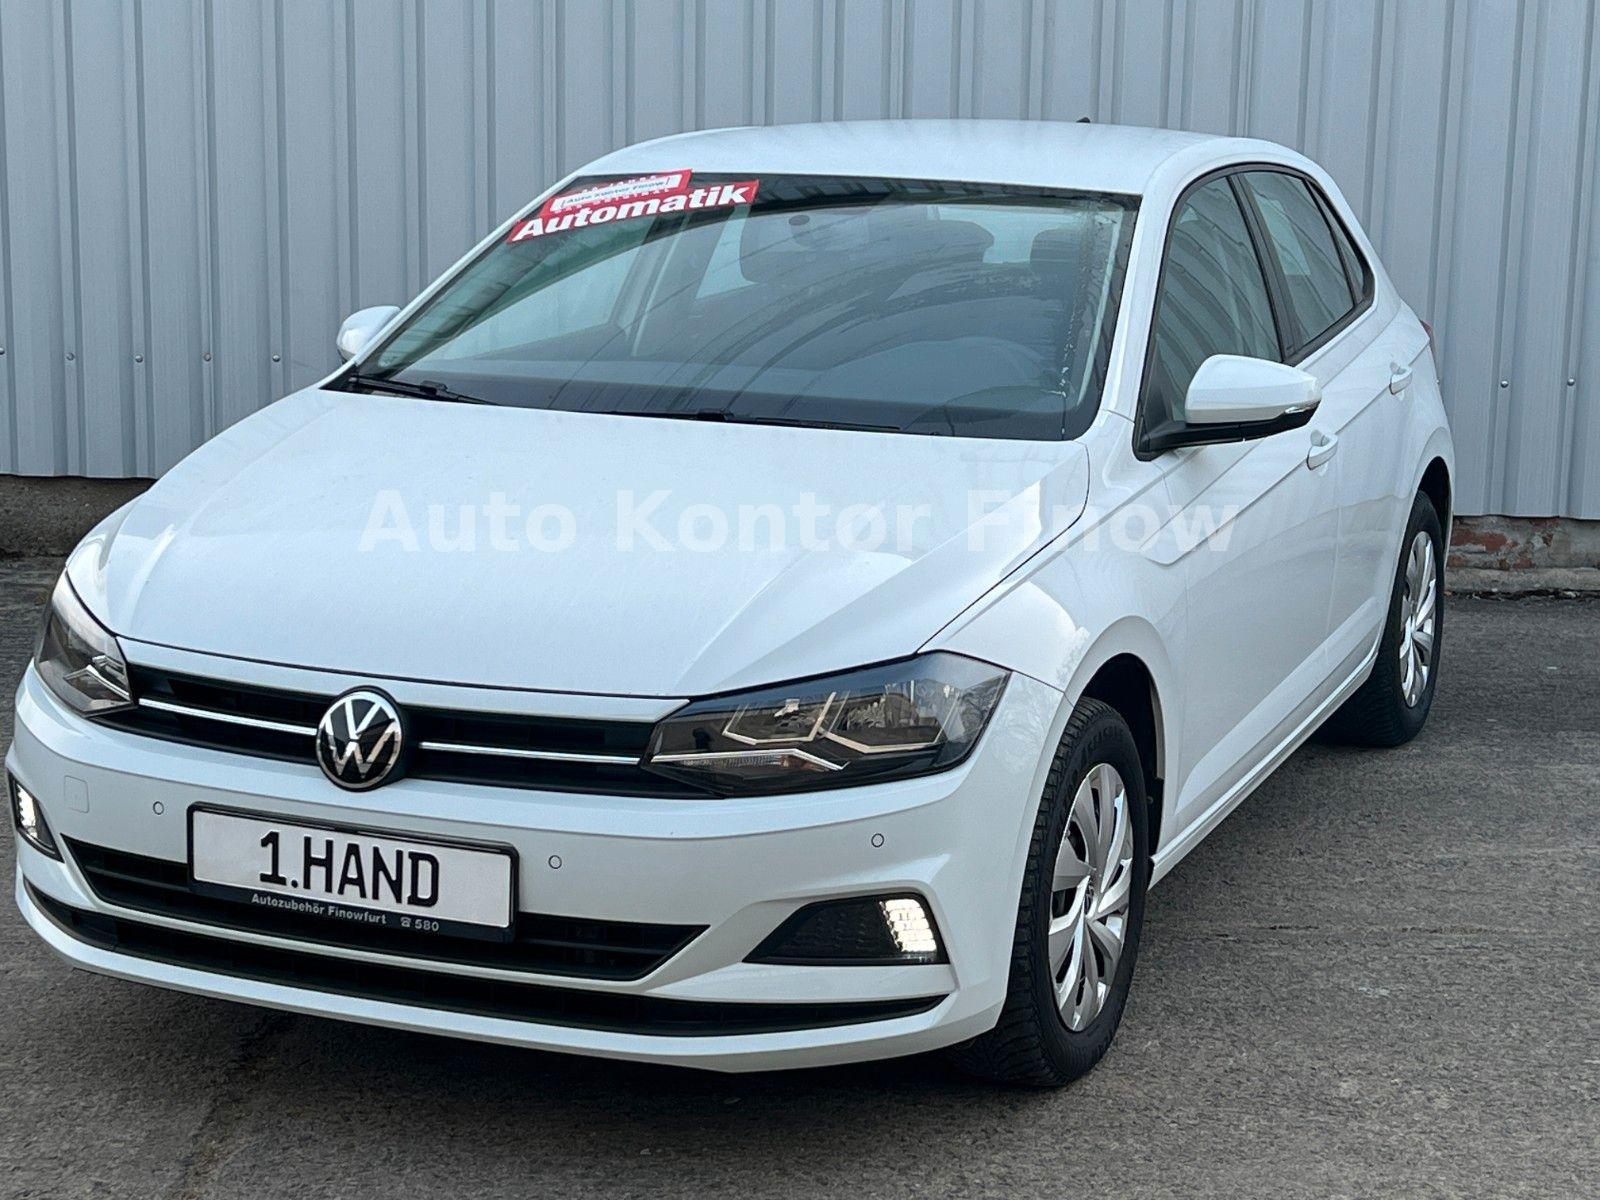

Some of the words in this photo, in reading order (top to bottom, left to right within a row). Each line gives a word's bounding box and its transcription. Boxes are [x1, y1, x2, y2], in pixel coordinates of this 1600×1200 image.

[511, 183, 751, 242] Automatik
[258, 829, 440, 908] 1.HAND
[250, 892, 324, 915] Autozubehör
[327, 905, 387, 925] Finowfurt
[414, 915, 440, 932] 580
